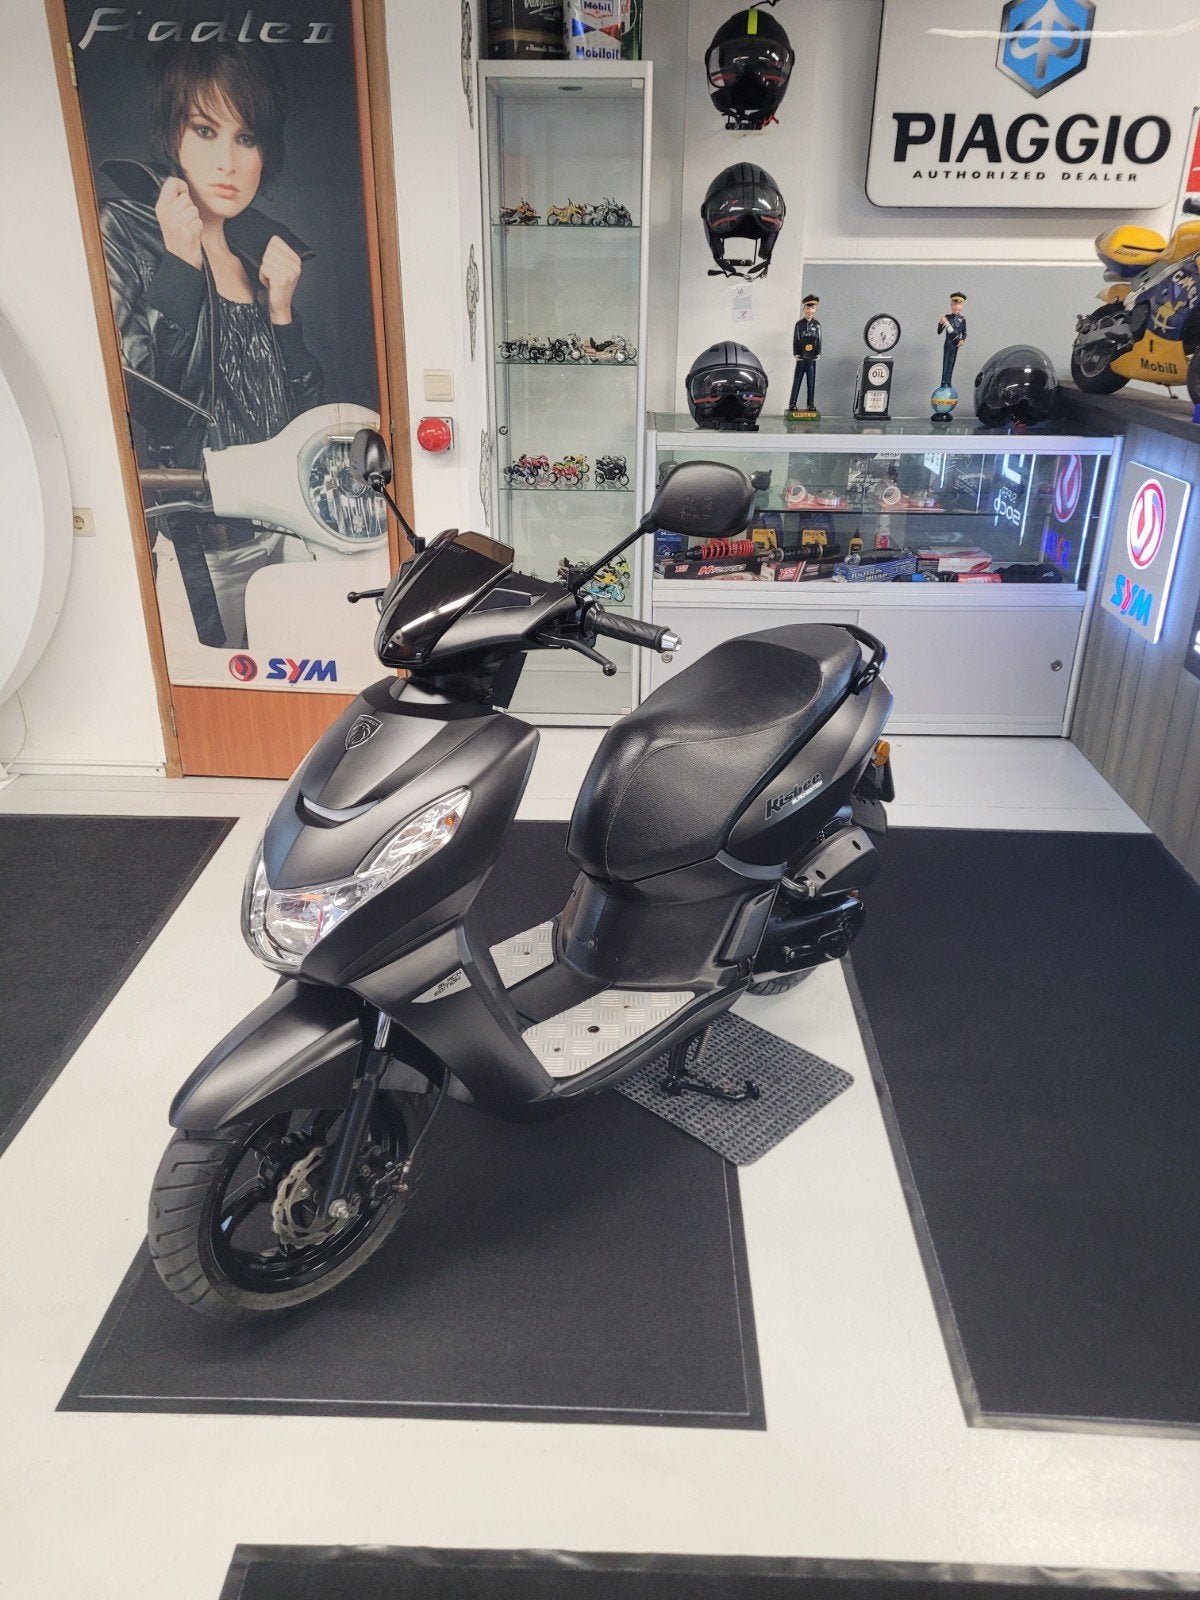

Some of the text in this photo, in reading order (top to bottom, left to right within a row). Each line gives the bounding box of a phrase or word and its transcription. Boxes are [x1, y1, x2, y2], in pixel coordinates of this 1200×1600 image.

[583, 1, 612, 13] Mobil
[77, 7, 291, 50] Fiddle
[575, 45, 620, 60] Mobiloil
[891, 112, 1171, 165] PIAGGIO
[912, 170, 1138, 182] AUTHORIZED DEALER
[871, 370, 885, 378] OIL
[1110, 574, 1153, 627] SYM
[266, 657, 338, 684] SYM
[765, 772, 821, 821] Kisbee
